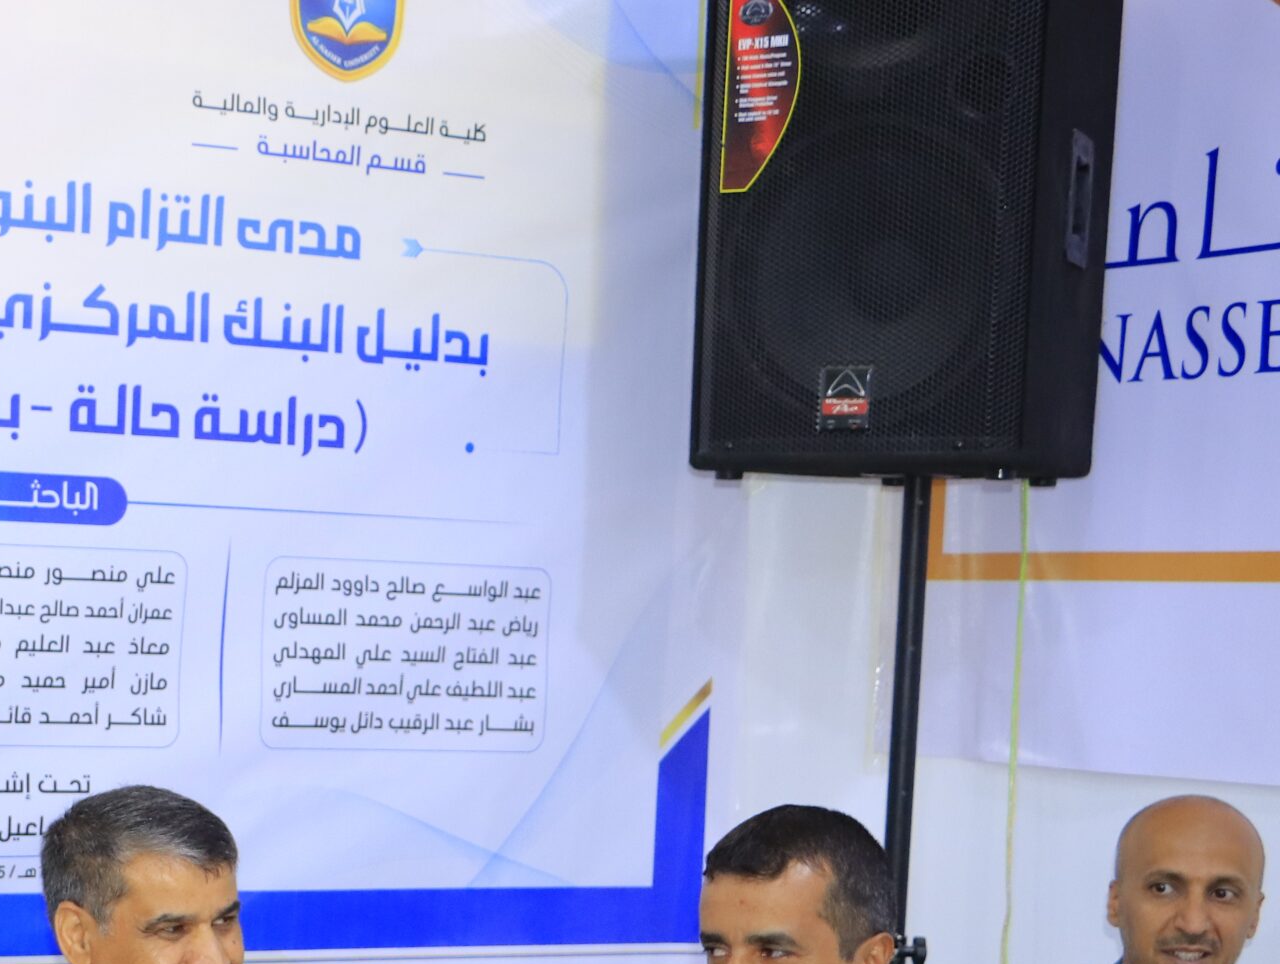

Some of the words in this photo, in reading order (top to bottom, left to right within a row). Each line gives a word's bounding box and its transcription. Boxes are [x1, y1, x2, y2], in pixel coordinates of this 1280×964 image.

[192, 90, 278, 121] والمالية
[285, 101, 360, 131] الإدارية
[365, 114, 434, 134] العلوم
[438, 121, 486, 145] كلية
[257, 134, 361, 166] المحاسبة
[366, 154, 426, 175] قسم
[106, 188, 225, 252] التزام
[237, 216, 361, 260] مدى
[223, 296, 344, 363] البنك
[356, 308, 489, 377] بدليل
[70, 383, 180, 438] حالة
[43, 565, 128, 585] منصور
[136, 566, 176, 592] علي
[275, 571, 324, 595] المزلم
[331, 574, 380, 597] داوود
[386, 576, 425, 600] صالح
[431, 580, 508, 602] الواسع
[513, 585, 541, 603] عبد
[39, 600, 80, 624] صالح
[84, 597, 124, 618] أحمد
[128, 603, 173, 624] عمران
[355, 613, 402, 628] محمد
[410, 612, 461, 634] الرحمن
[467, 617, 496, 636] عبد
[502, 615, 539, 637] رياض
[15, 634, 70, 659] العليم
[83, 639, 116, 659] عبد
[128, 636, 169, 655] معاذ
[273, 641, 346, 667] المهدلي
[355, 643, 392, 669] علي
[401, 645, 446, 666] السيد
[453, 646, 499, 671] الفتاح
[507, 651, 537, 670] عبد
[21, 675, 66, 693] حميد
[81, 665, 116, 694] أمير
[130, 671, 168, 695] مازن
[273, 675, 362, 702] المساري
[365, 673, 404, 696] أحمد
[406, 679, 442, 704] علي
[446, 680, 503, 702] اللطيف
[507, 684, 536, 703] عبد
[38, 701, 99, 725] أحمد
[105, 706, 167, 730] شاكر
[271, 711, 347, 734] يوسف
[389, 712, 440, 736] الرقيب
[478, 713, 535, 737] بشار
[444, 716, 474, 736] عبد
[38, 774, 91, 794] تحت
